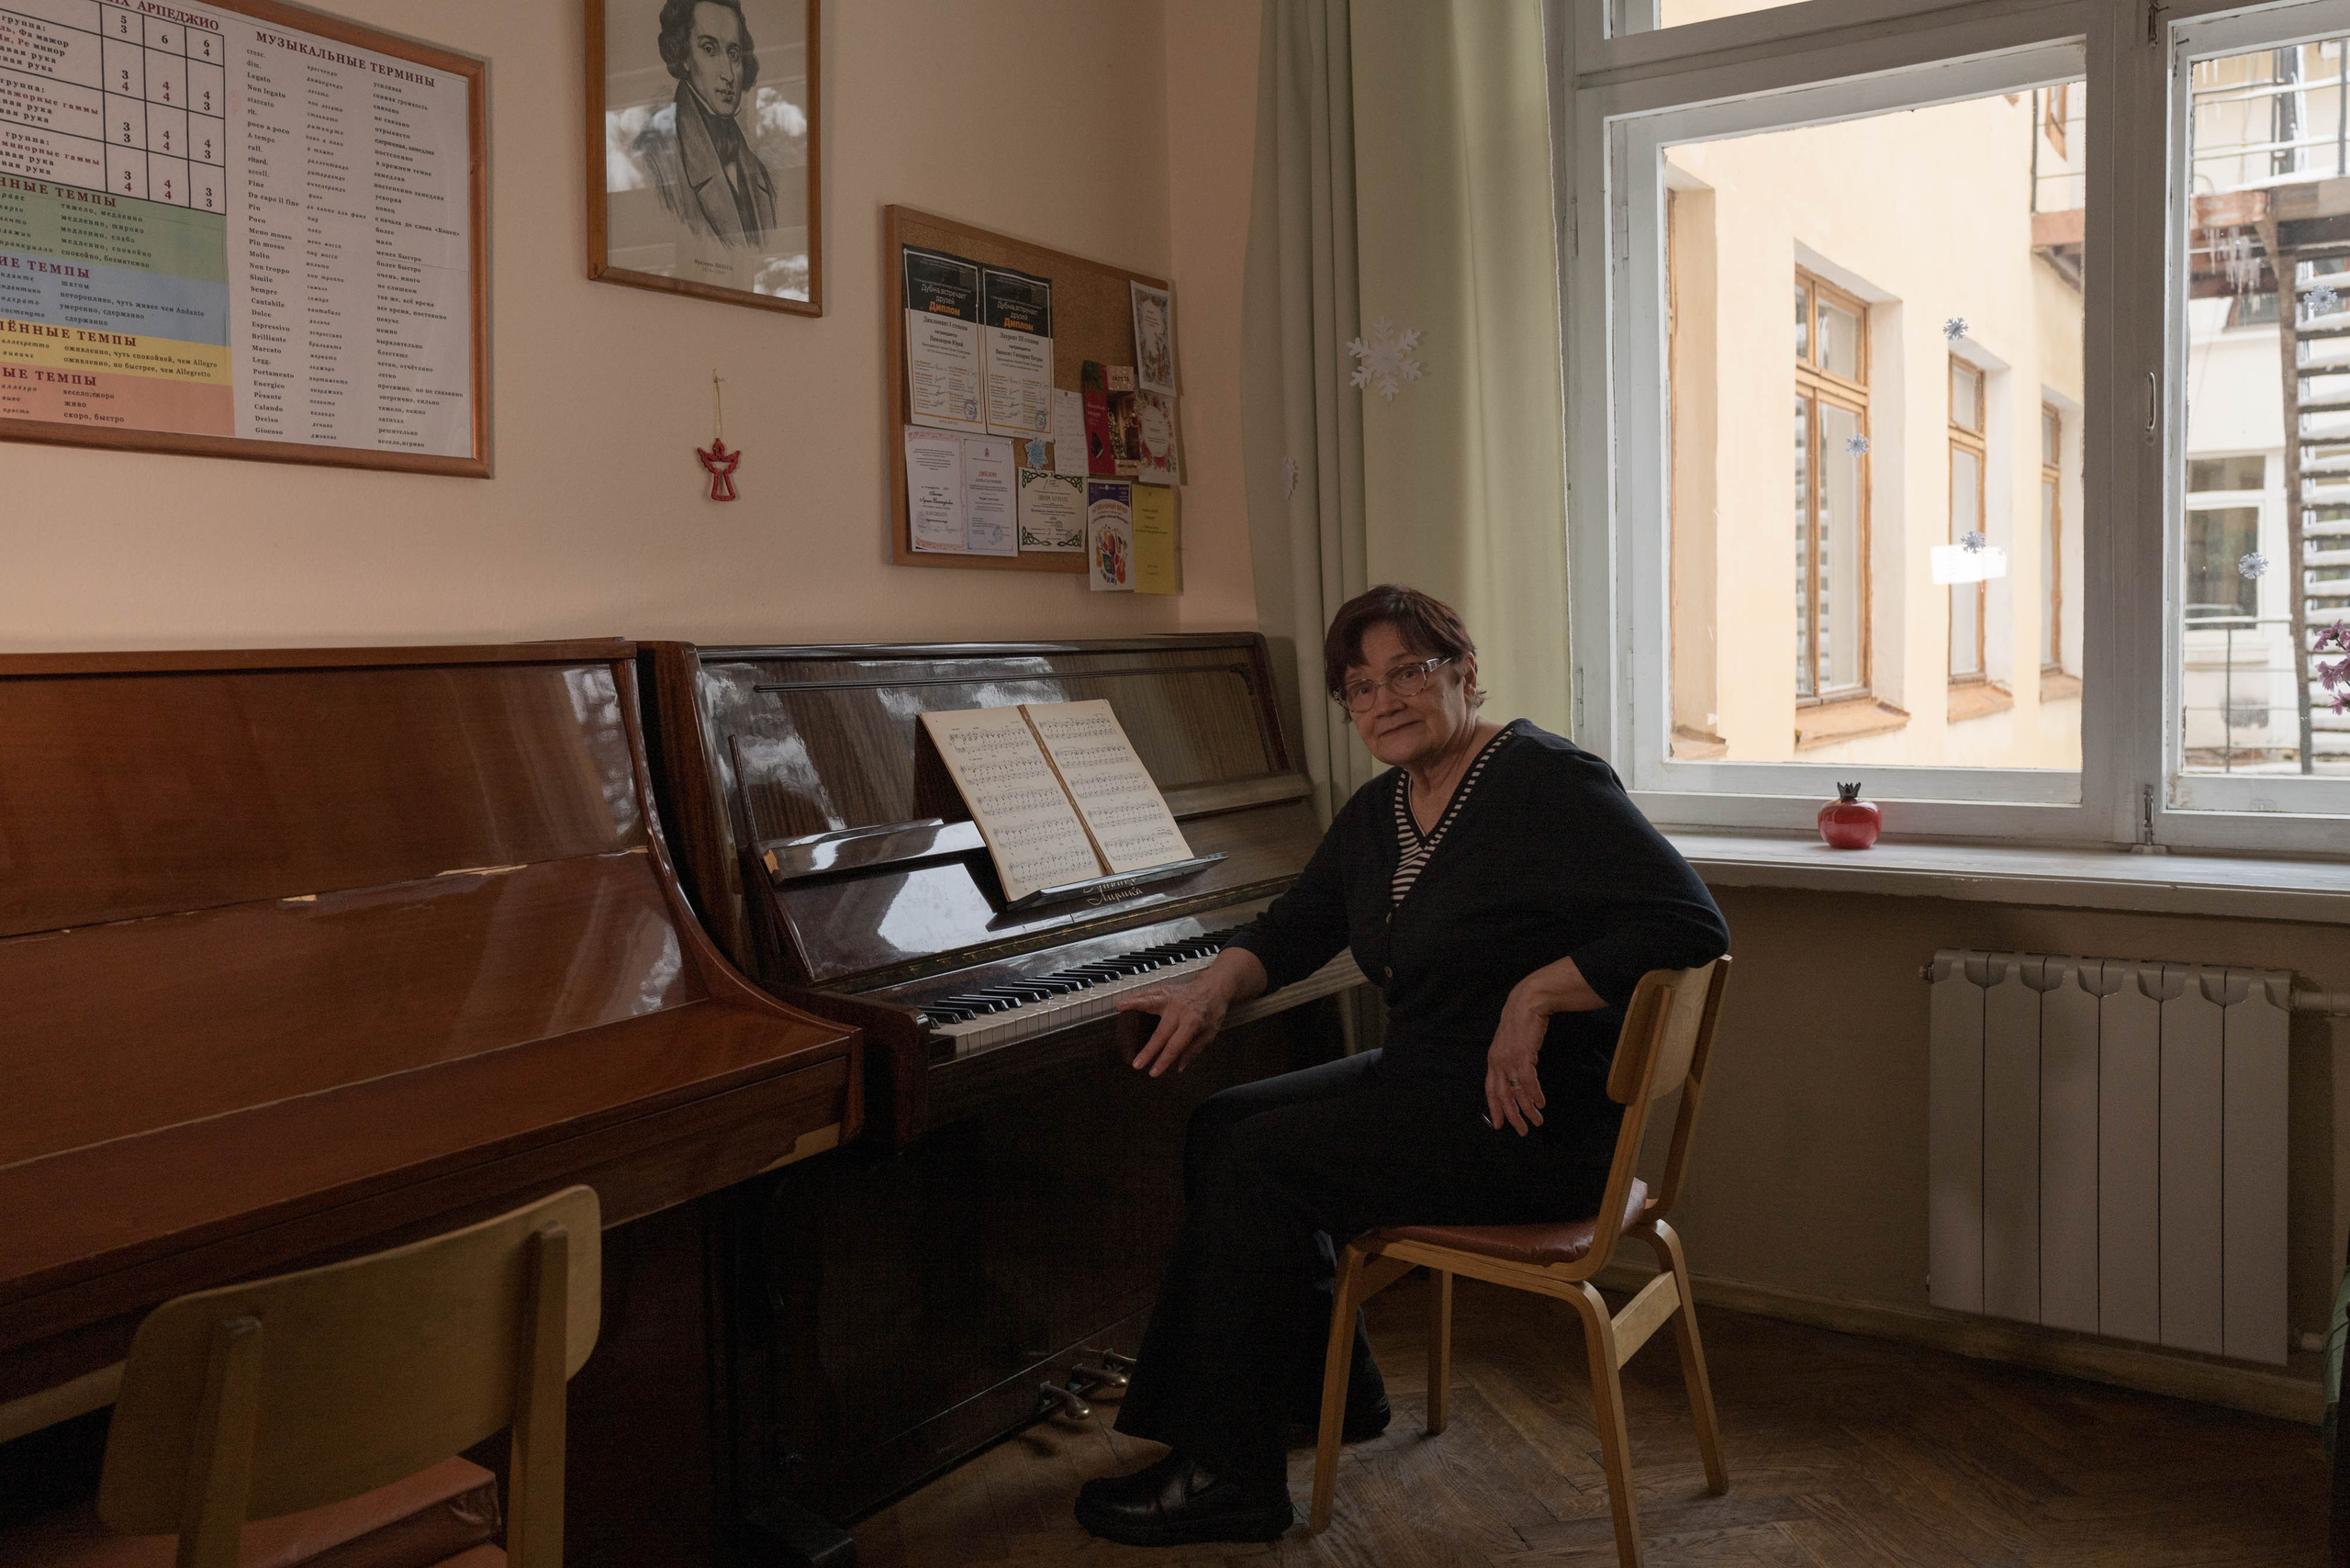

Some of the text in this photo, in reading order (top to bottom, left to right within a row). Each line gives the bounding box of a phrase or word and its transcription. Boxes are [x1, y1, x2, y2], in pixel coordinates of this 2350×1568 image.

[119, 15, 127, 24] 5
[137, 3, 218, 30] АРПЕДЖИО
[1, 15, 45, 31] группа:
[120, 24, 127, 33] 3
[18, 28, 69, 48] Фа мажор
[161, 34, 168, 44] 6
[17, 38, 65, 57] Ре минор
[203, 39, 209, 48] 6
[30, 52, 56, 63] рука
[203, 48, 209, 57] 4
[255, 30, 434, 87] МУЗЫКАЛЬНЫЕ ТЕРМИНЫ
[28, 62, 52, 73] рука
[246, 59, 262, 69] dim.
[121, 70, 129, 79] 3
[247, 72, 270, 83] Legato
[0, 78, 44, 93] группа:
[121, 81, 129, 91] 4
[162, 81, 170, 90] 4
[203, 90, 210, 100] 4
[247, 84, 285, 98] Non legato
[162, 92, 170, 102] 4
[247, 97, 274, 107] staccato
[27, 104, 52, 114] рука
[62, 102, 98, 115] гаммы
[203, 101, 210, 110] 3
[23, 112, 49, 123] рука
[123, 121, 130, 131] 3
[6, 131, 49, 145] группа:
[123, 132, 130, 142] 3
[162, 130, 170, 140] 4
[254, 134, 274, 143] tempo
[162, 141, 170, 151] 4
[204, 139, 211, 148] 4
[1, 140, 99, 165] минорные гаммы
[204, 149, 210, 159] 3
[28, 156, 53, 166] рука
[248, 156, 268, 165] ritard.
[25, 165, 50, 174] рука
[124, 170, 131, 180] 3
[124, 182, 132, 192] 4
[163, 179, 172, 189] 4
[248, 179, 264, 187] Fine
[54, 186, 116, 207] ТЕМПЫ
[164, 190, 172, 199] 4
[206, 187, 212, 196] 3
[206, 197, 212, 207] 3
[285, 198, 299, 207] fine
[101, 210, 142, 222] медленно
[248, 215, 265, 223] Poco
[112, 223, 143, 233] широко
[249, 227, 268, 235] Meno
[111, 235, 134, 243] слабо
[111, 246, 151, 257] спокойно
[249, 250, 269, 259] Molto
[104, 255, 149, 268] безмятежно
[397, 252, 421, 262] быстро
[27, 260, 89, 278] ТЕМПЫ
[249, 262, 289, 274] Non troppo
[250, 274, 273, 283] Simile
[61, 280, 89, 289] шагом
[250, 286, 277, 295] Sempre
[251, 297, 285, 308] Cantabile
[176, 307, 204, 317] Andante
[252, 309, 271, 318] Dolce
[929, 301, 960, 316] Диплом
[103, 309, 144, 319] сдержанно
[64, 316, 107, 325] сдержанно
[252, 320, 290, 331] Espressivo
[1004, 317, 1034, 331] Диплом
[76, 330, 136, 346] ТЕМПЫ
[252, 332, 286, 342] Brilliante
[252, 344, 281, 353] Marcato
[193, 359, 217, 367] Allegro
[252, 356, 271, 365] Legg.
[175, 367, 210, 377] Allegretto
[253, 368, 294, 378] Portamento
[35, 370, 96, 386] ТЕМПЫ
[253, 380, 285, 388] Energico
[94, 413, 124, 423] быстро
[1087, 887, 1144, 906] Лирика
